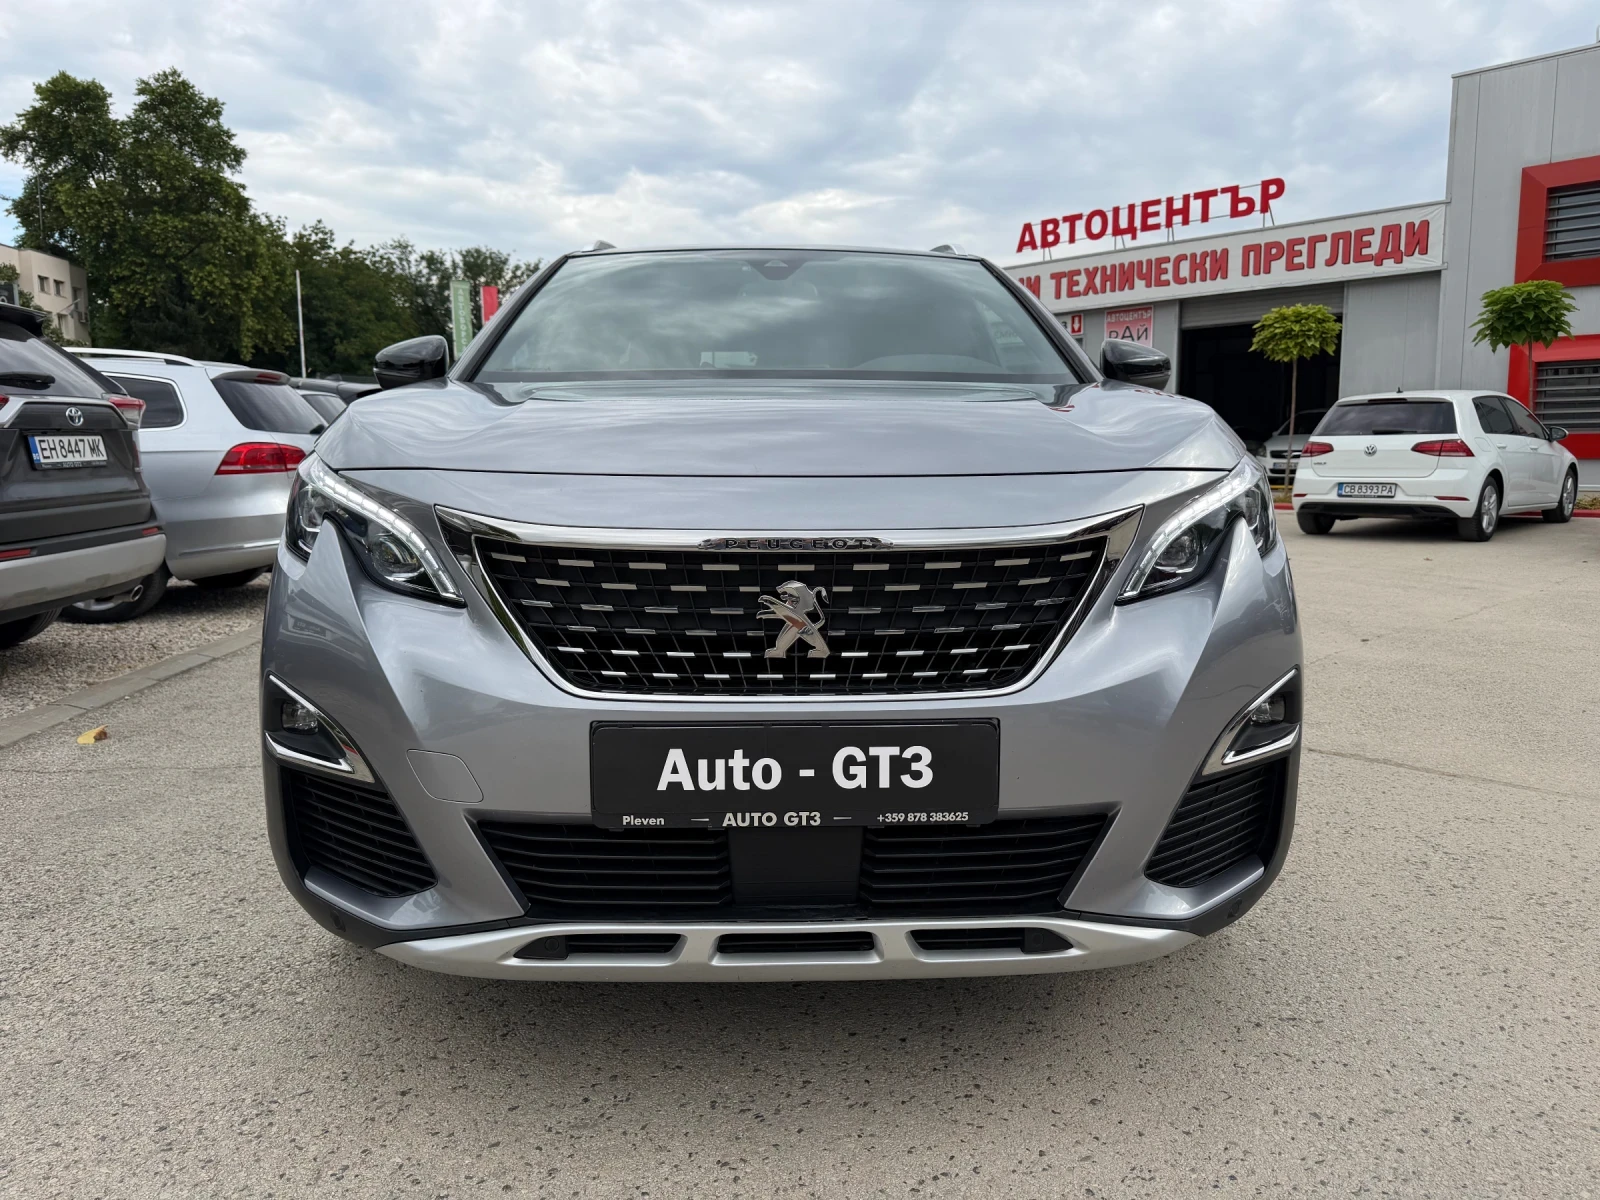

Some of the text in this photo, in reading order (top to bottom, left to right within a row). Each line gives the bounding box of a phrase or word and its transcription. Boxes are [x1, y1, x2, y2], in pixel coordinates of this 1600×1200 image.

[1016, 177, 1286, 253] АВТОЦЕНТЪР
[1018, 219, 1430, 300] И ТЕХНИЧЕСКИ ПРЕГЛЕДИ
[1106, 309, 1152, 323] АВТОЦЕНТЪР
[38, 438, 59, 460] EH
[59, 438, 86, 459] 8447
[87, 438, 105, 458] MK
[1343, 485, 1393, 495] CB 8393 PA
[724, 538, 870, 550] PEUGEOT
[656, 748, 783, 791] Auto
[832, 745, 934, 790] GT3
[622, 811, 969, 827] Pleven AUTO GT3 +359 878 383625
